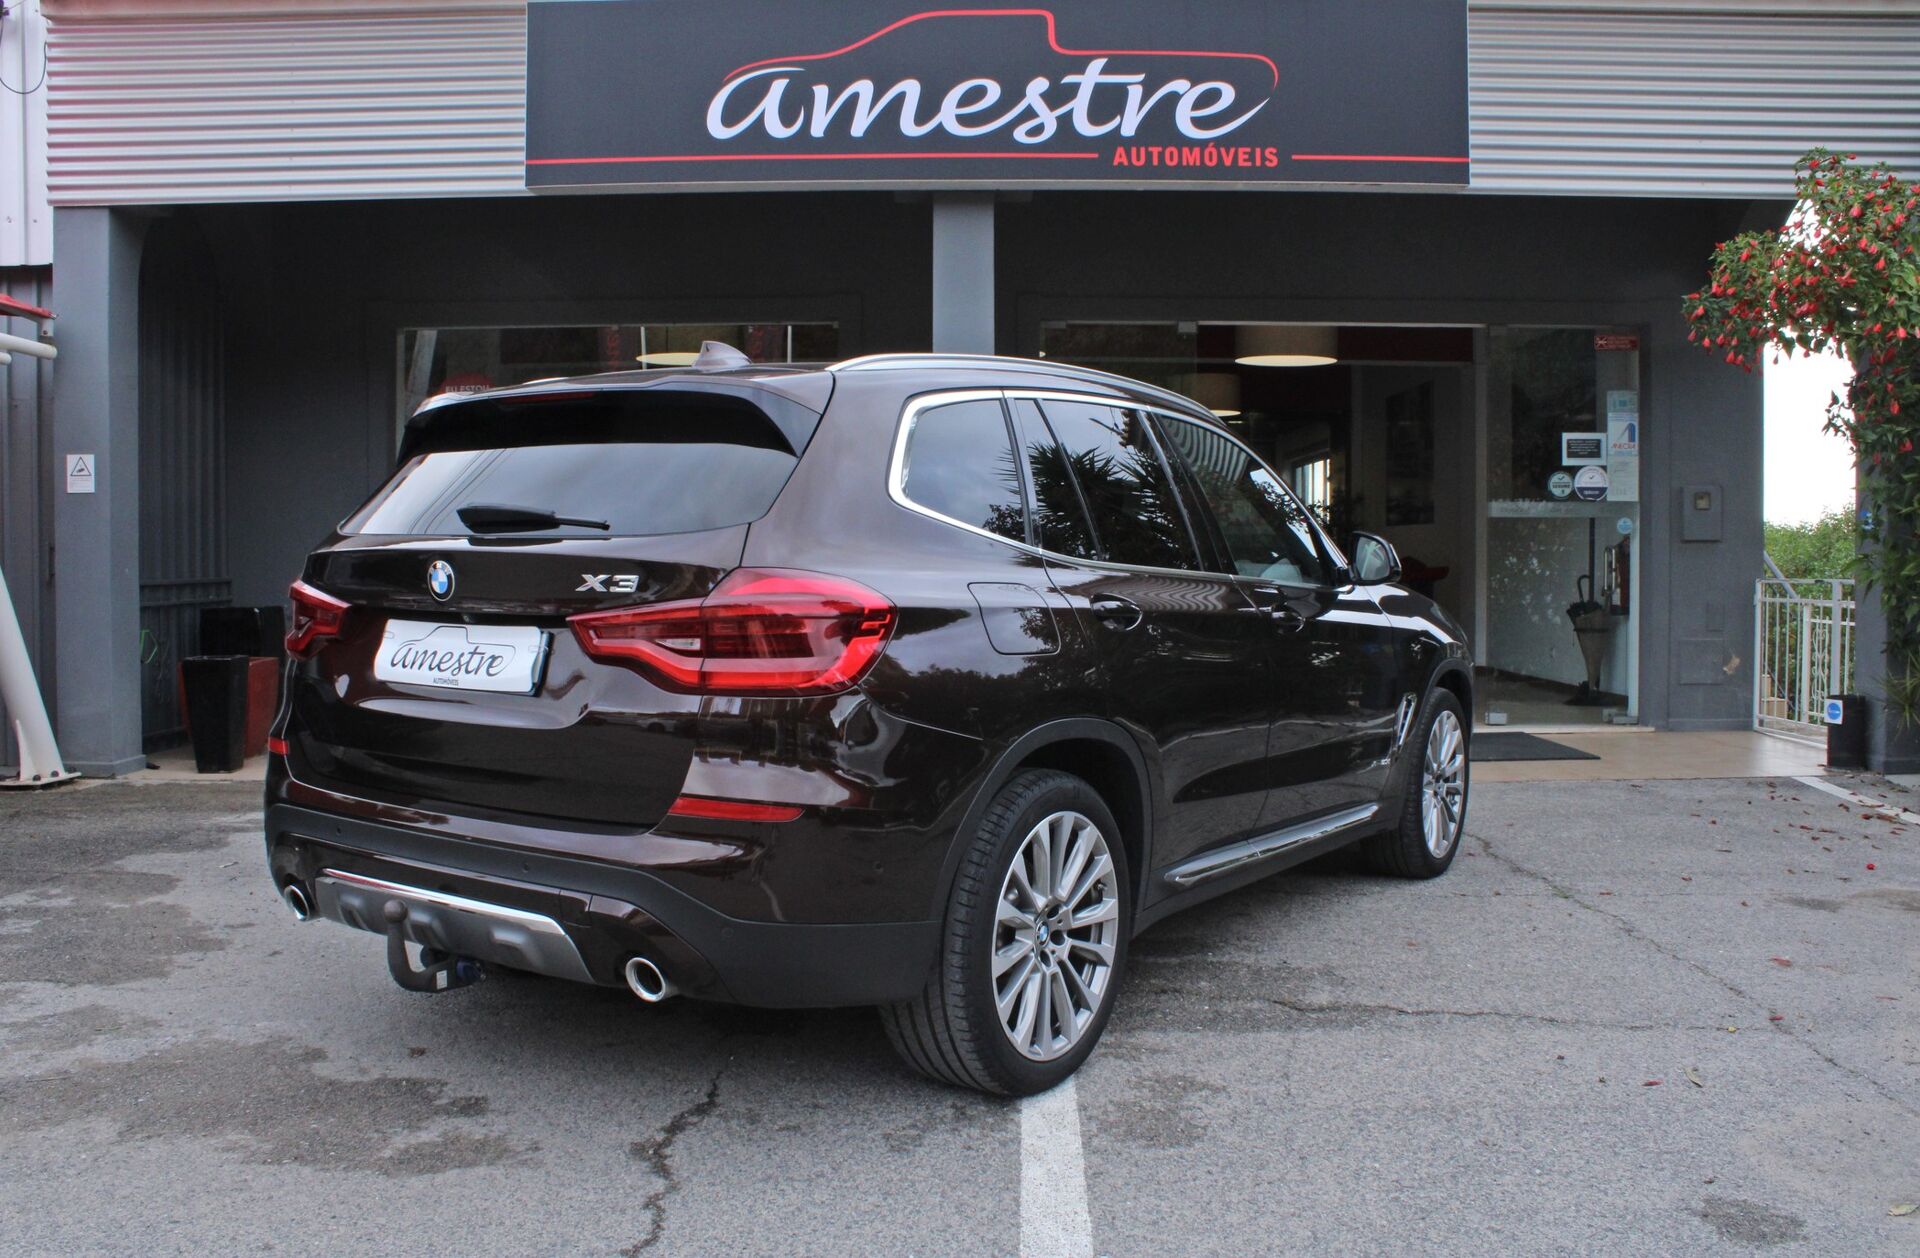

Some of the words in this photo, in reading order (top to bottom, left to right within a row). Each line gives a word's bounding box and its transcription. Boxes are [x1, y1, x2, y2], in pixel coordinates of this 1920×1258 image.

[706, 57, 1271, 144] amestre
[1112, 142, 1279, 168] AUTOMÓVEIS
[575, 574, 639, 593] X3
[390, 643, 506, 677] amestre
